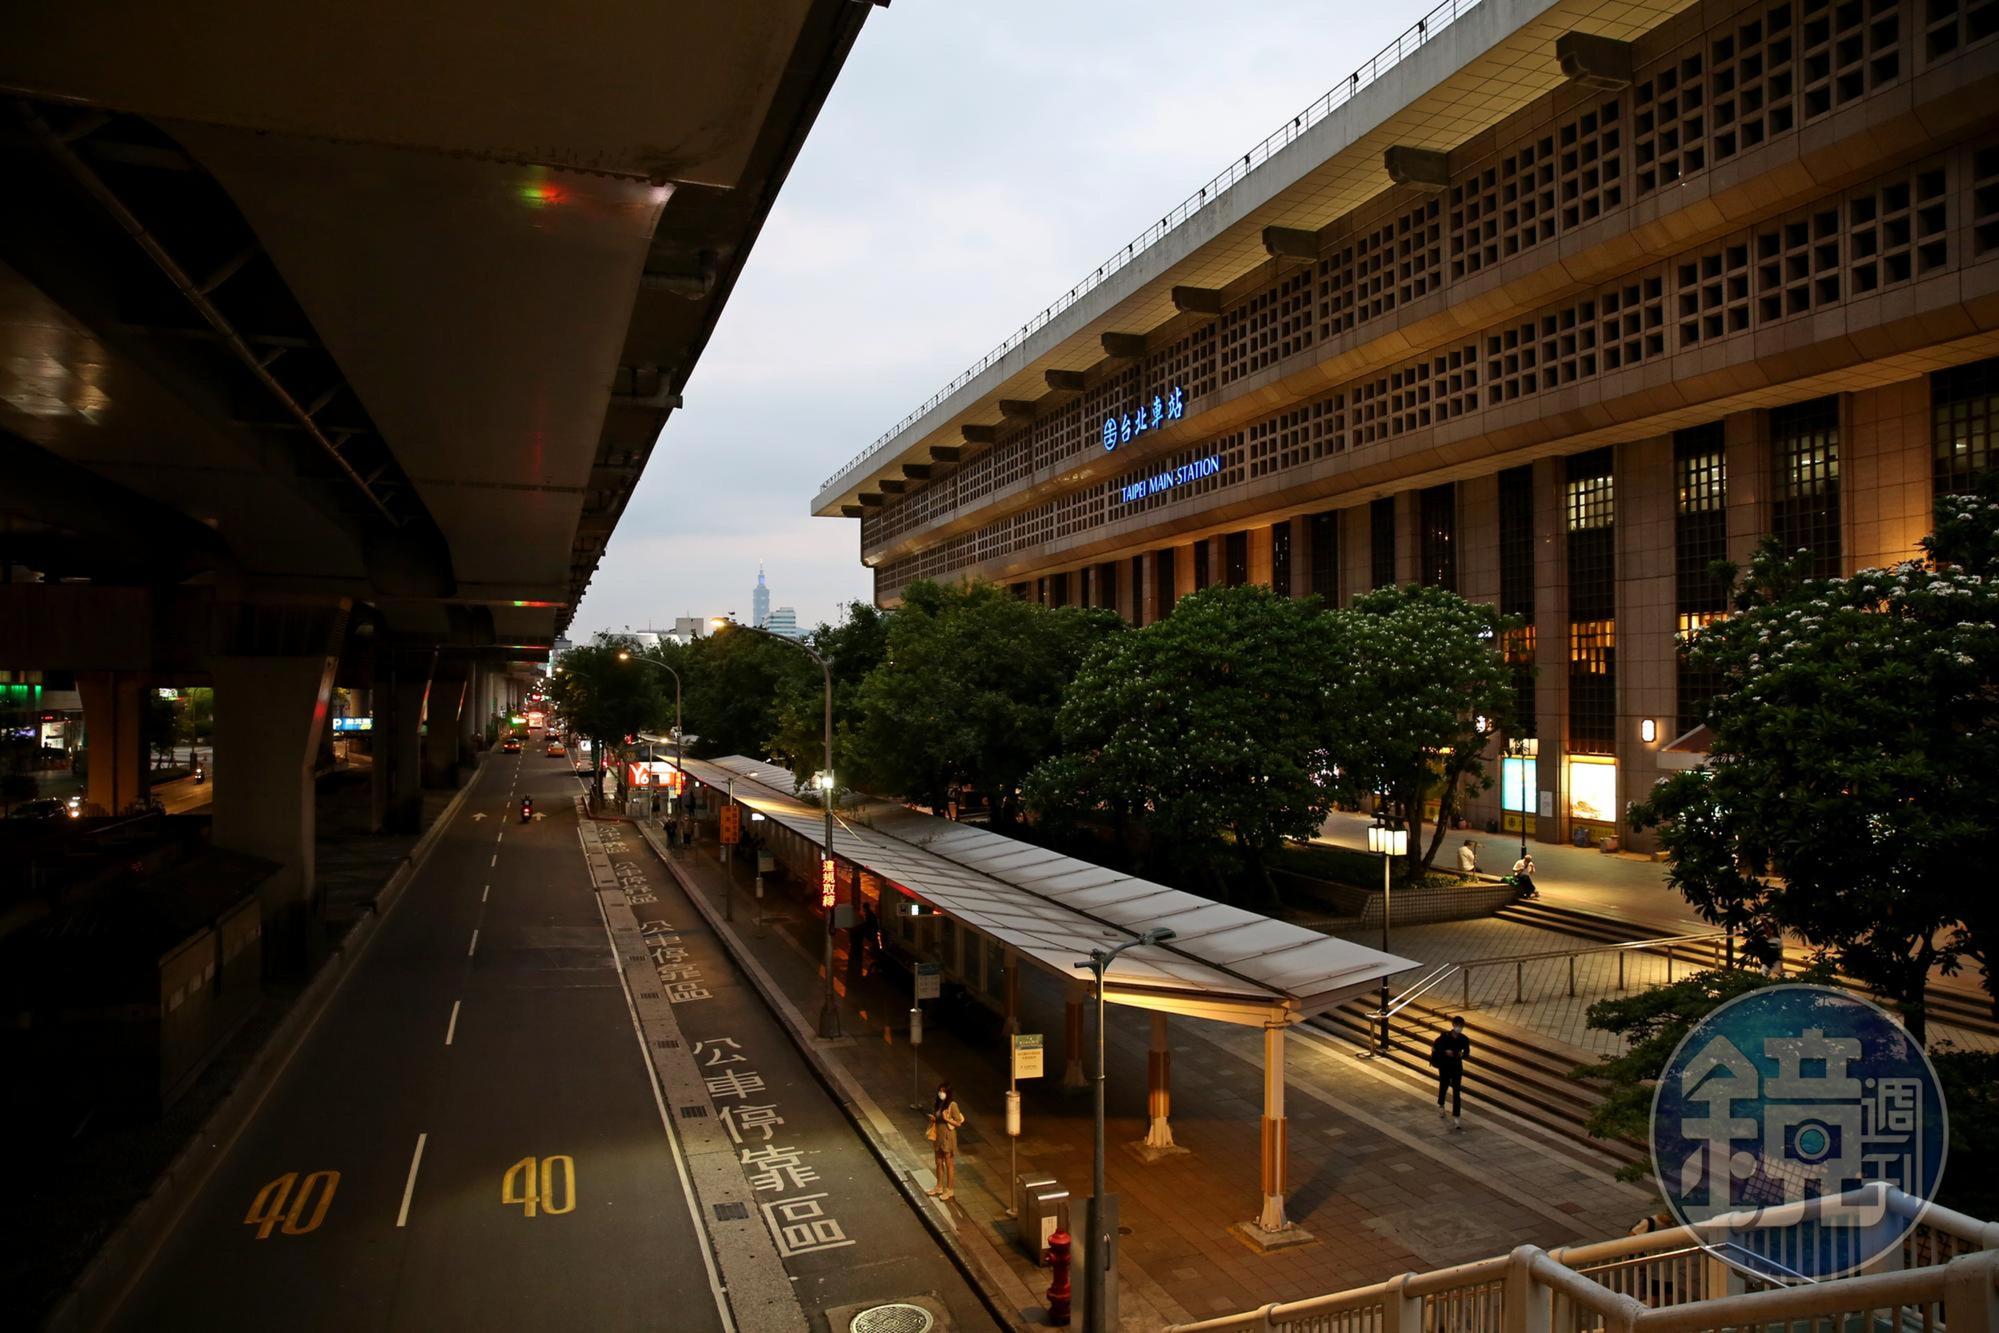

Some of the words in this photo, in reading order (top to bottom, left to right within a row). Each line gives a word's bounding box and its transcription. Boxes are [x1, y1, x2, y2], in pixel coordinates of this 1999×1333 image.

[1121, 387, 1183, 443] 台北車站
[1122, 481, 1146, 503] TAIPEI
[1149, 471, 1174, 494] MAIN
[1177, 455, 1220, 485] STATION
[823, 860, 835, 907] 違規取締
[640, 920, 714, 1004] 公車停靠區
[693, 1037, 857, 1258] 公車停靠區
[244, 1171, 341, 1239] 40
[502, 1155, 576, 1217] 40
